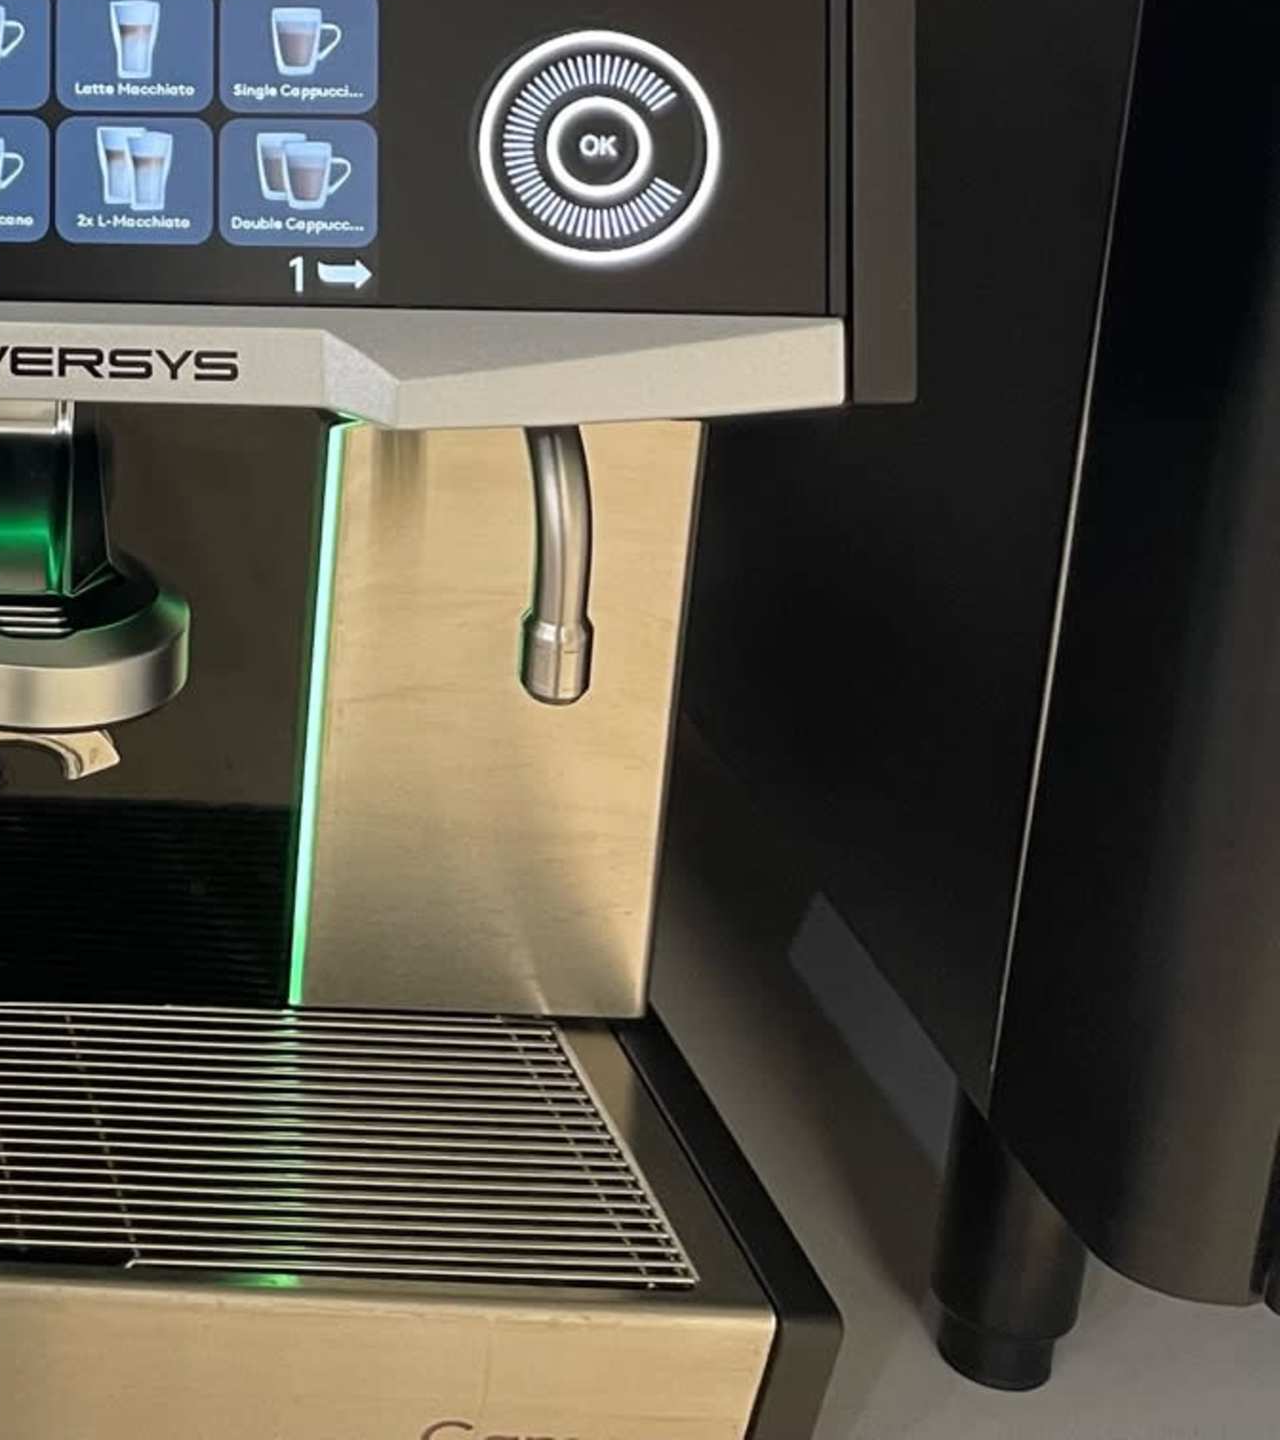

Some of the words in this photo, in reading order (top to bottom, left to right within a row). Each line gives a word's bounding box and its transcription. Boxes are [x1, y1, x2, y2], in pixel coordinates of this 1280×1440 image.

[74, 82, 114, 96] Latte
[117, 83, 196, 97] Macchiato
[233, 83, 277, 100] Single
[579, 134, 618, 157] OK
[76, 213, 94, 229] 2x
[97, 214, 192, 229] L-Macchiato
[231, 216, 283, 231] Double
[289, 255, 304, 293] 1
